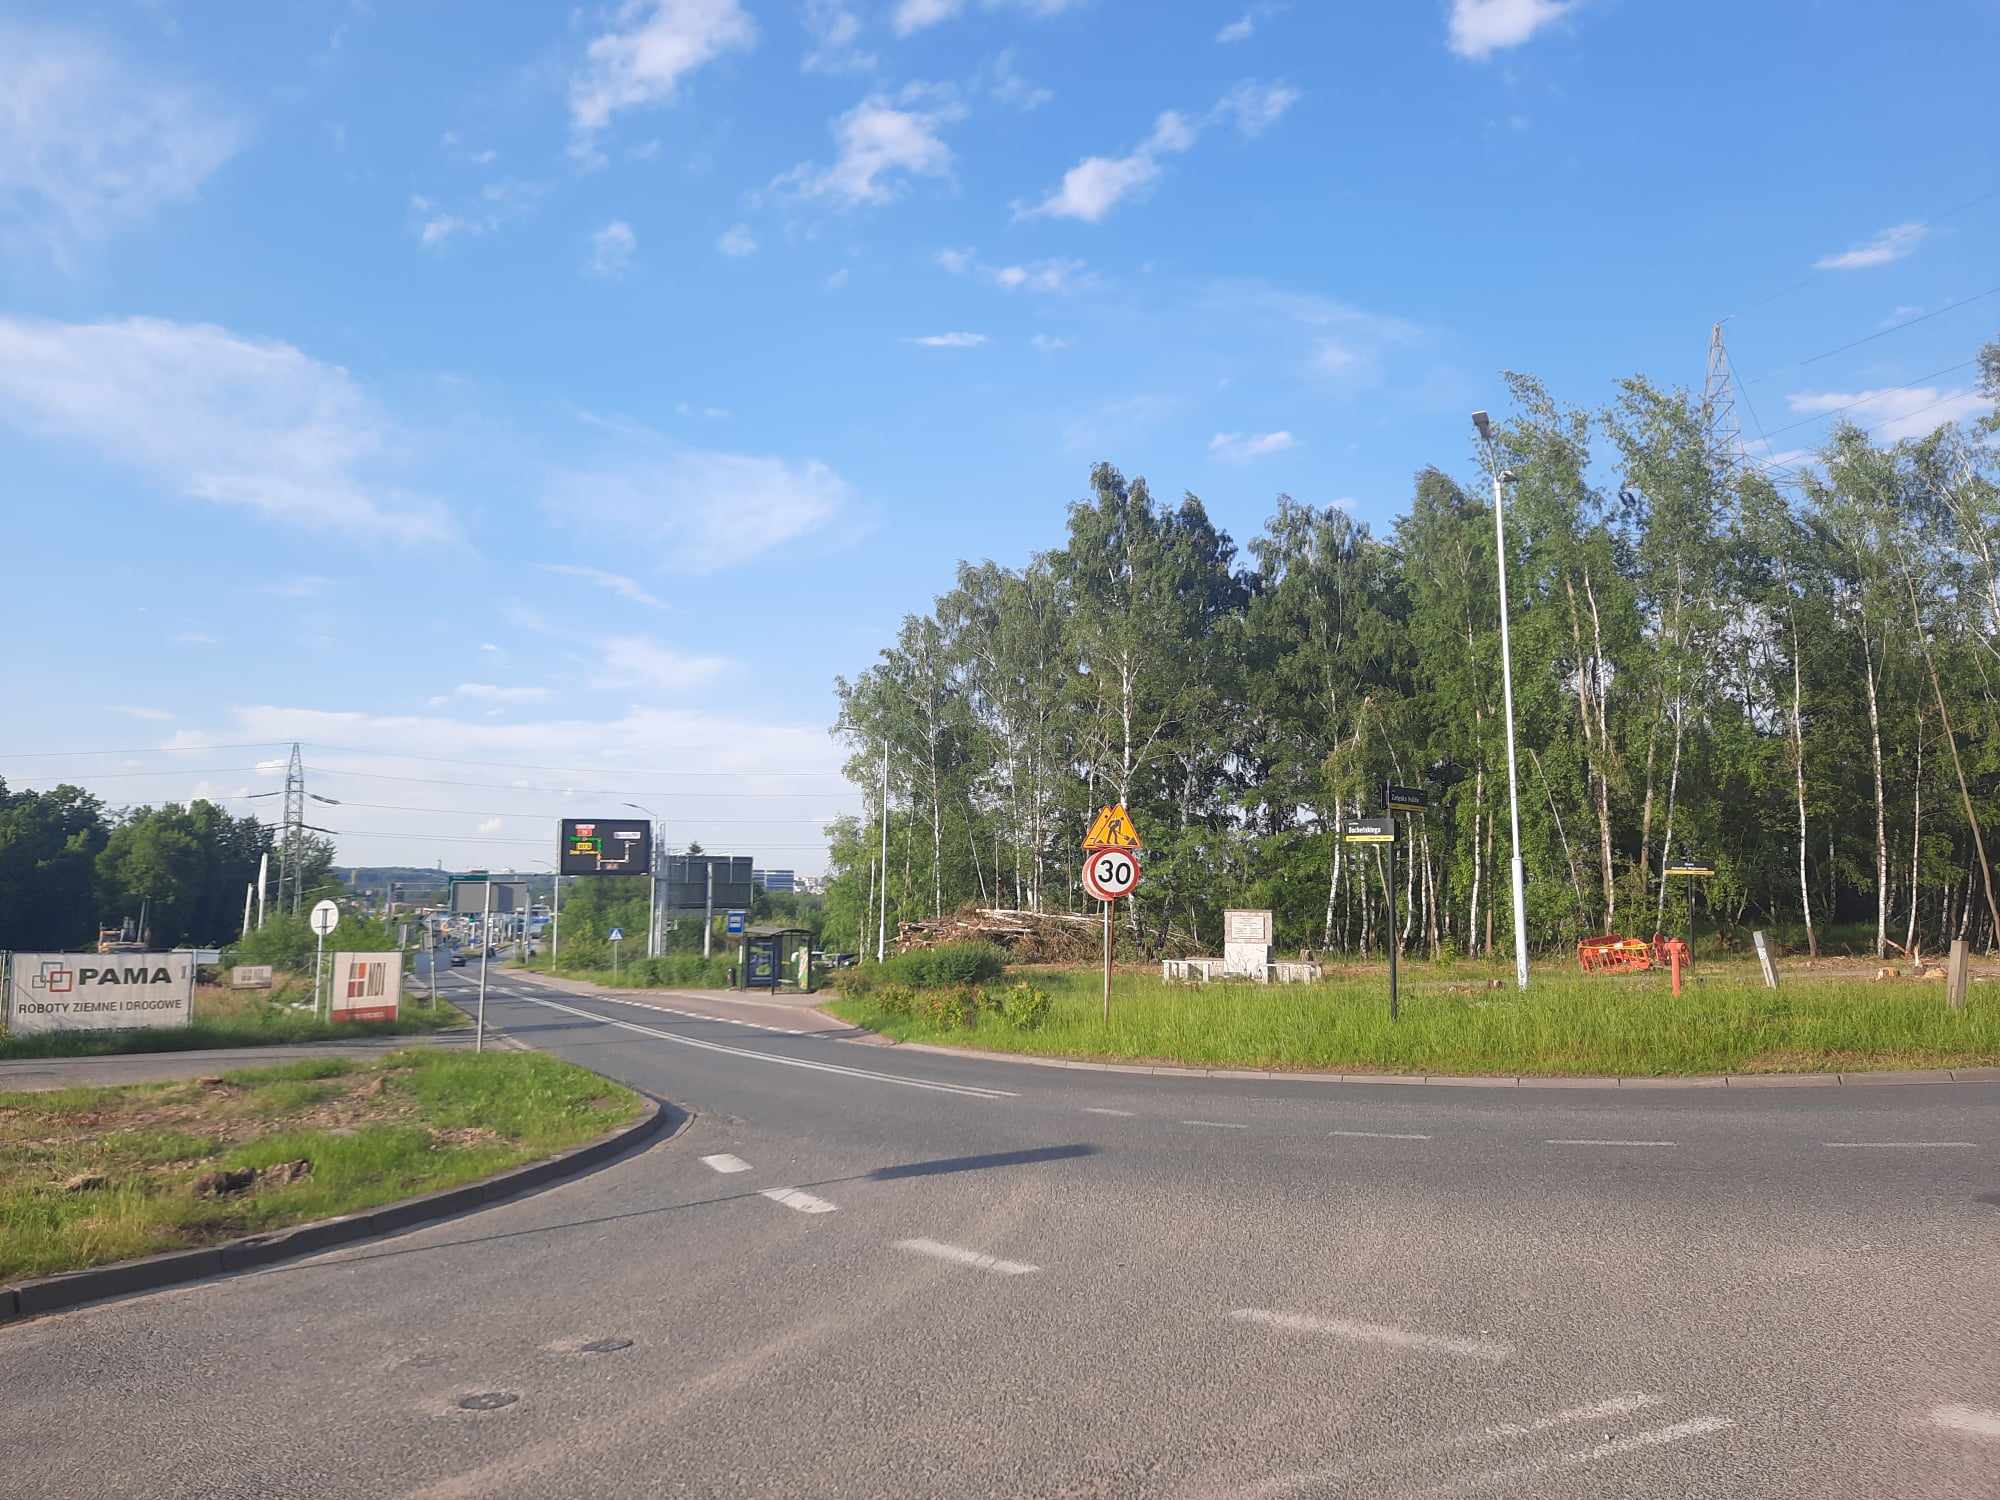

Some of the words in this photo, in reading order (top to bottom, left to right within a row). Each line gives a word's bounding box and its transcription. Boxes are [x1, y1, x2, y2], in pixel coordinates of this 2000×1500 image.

[1097, 859, 1131, 885] 30
[78, 967, 172, 986] PAMA
[18, 1002, 70, 1015] ROBOTY
[72, 1001, 118, 1013] ZIEMNE
[125, 999, 182, 1012] DROGOWE
